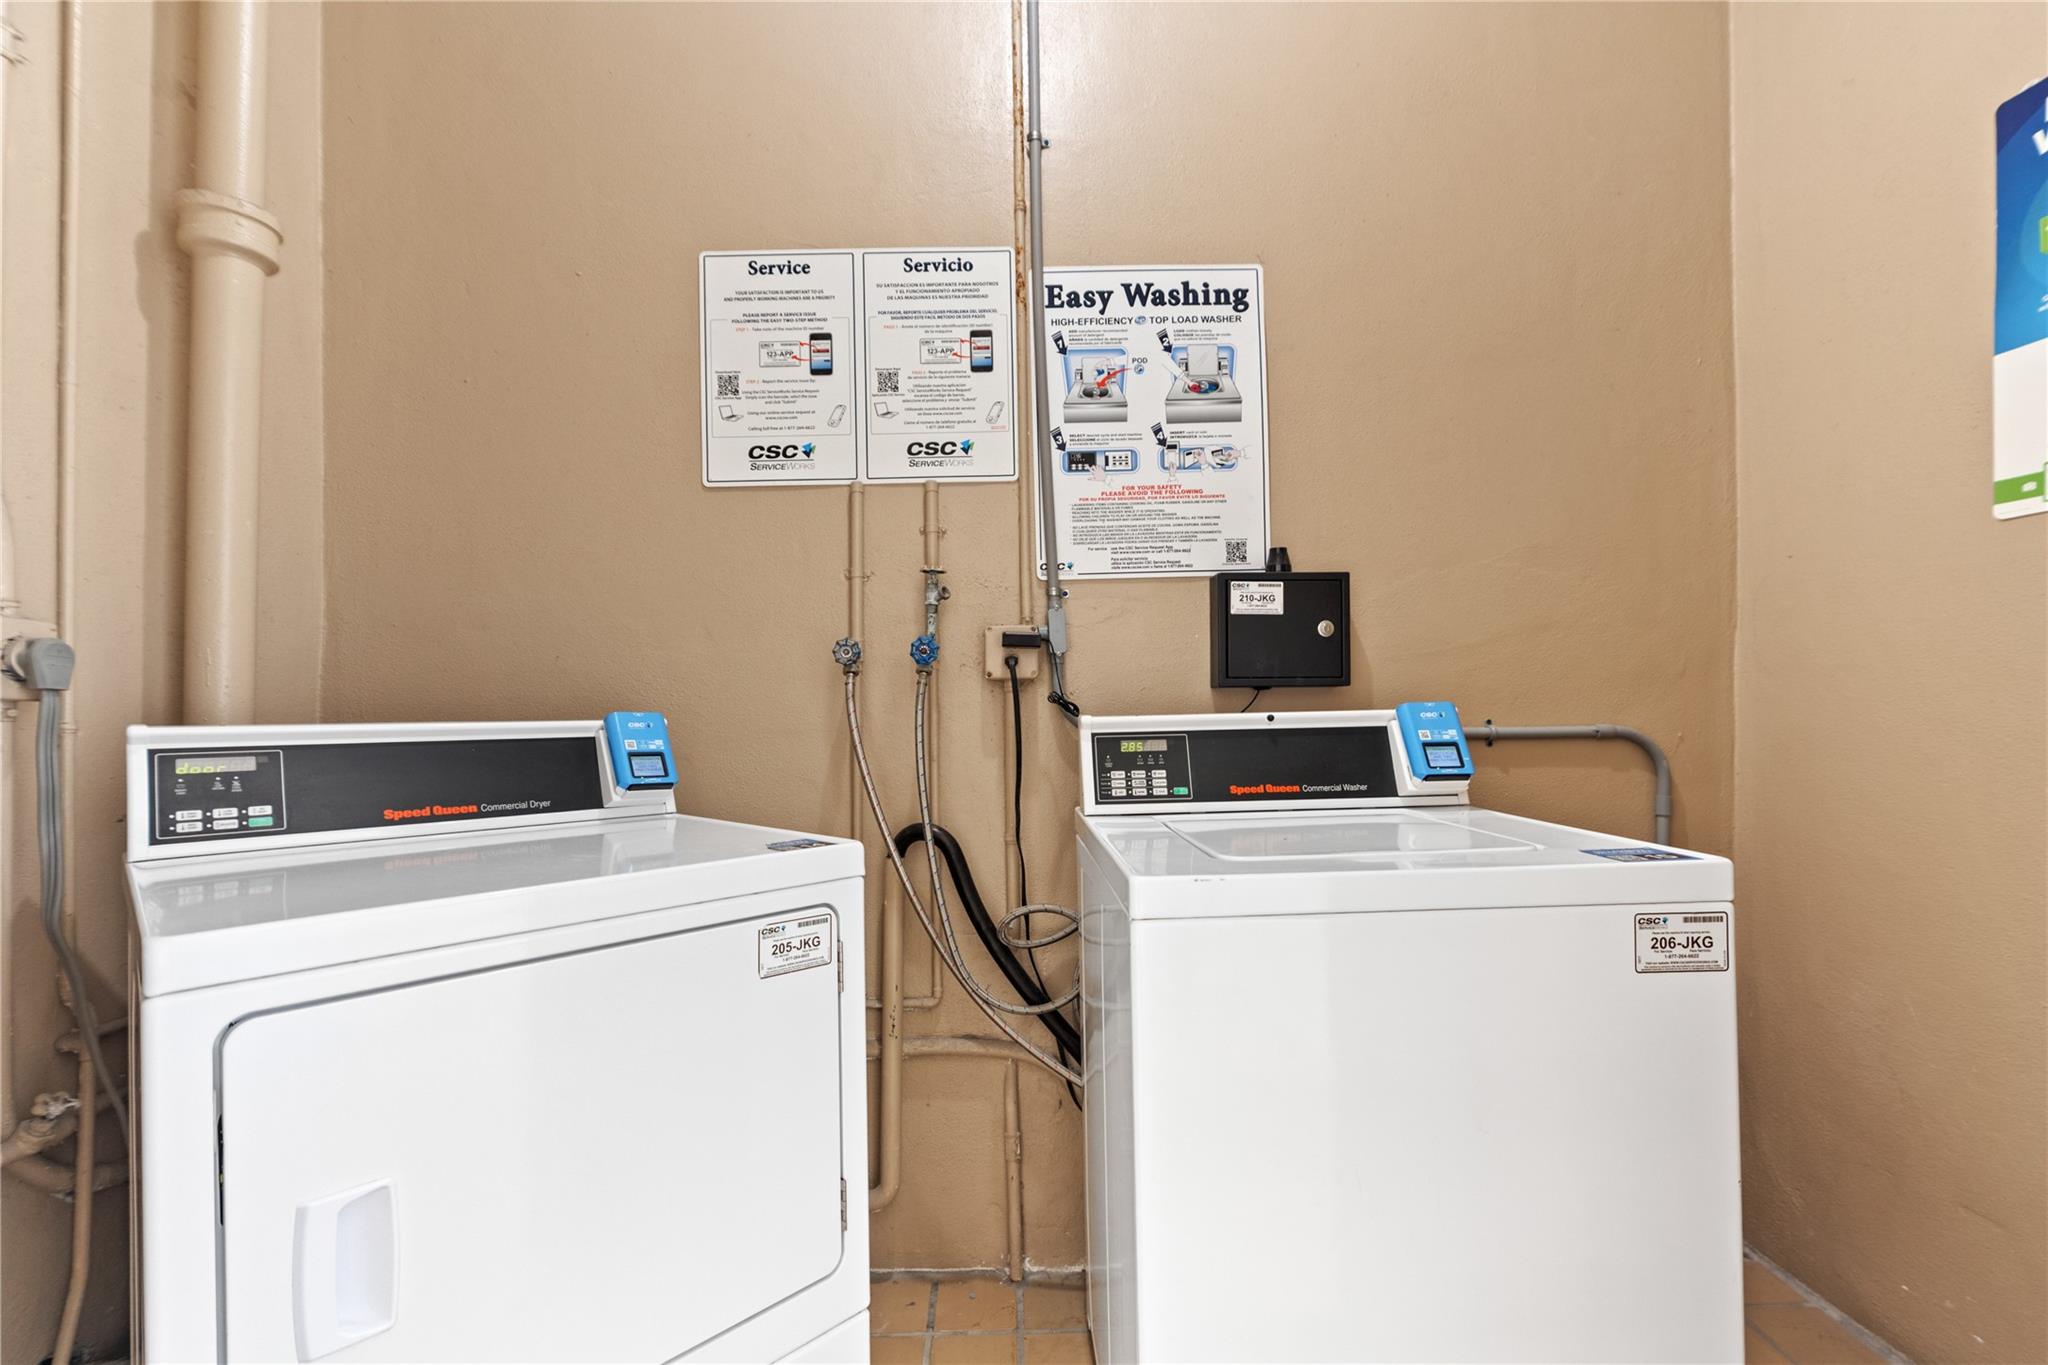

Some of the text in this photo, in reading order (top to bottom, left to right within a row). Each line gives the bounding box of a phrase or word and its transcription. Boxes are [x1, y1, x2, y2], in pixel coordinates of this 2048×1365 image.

[748, 260, 810, 275] Service
[903, 257, 973, 272] Servicio
[1045, 281, 1249, 315] Easy Washing
[1051, 317, 1133, 326] HIGH-EFFICIENCY
[748, 445, 798, 459] CSC
[907, 442, 957, 456] CSC
[1229, 784, 1264, 795] Speed
[1265, 784, 1300, 793] Queen
[1302, 784, 1341, 792] Commercial
[384, 800, 551, 820] Speed Queen Commercial Dryer
[762, 926, 780, 935] CSC
[772, 936, 821, 956] 205-JKG
[1651, 936, 1714, 949] 206-JKG
